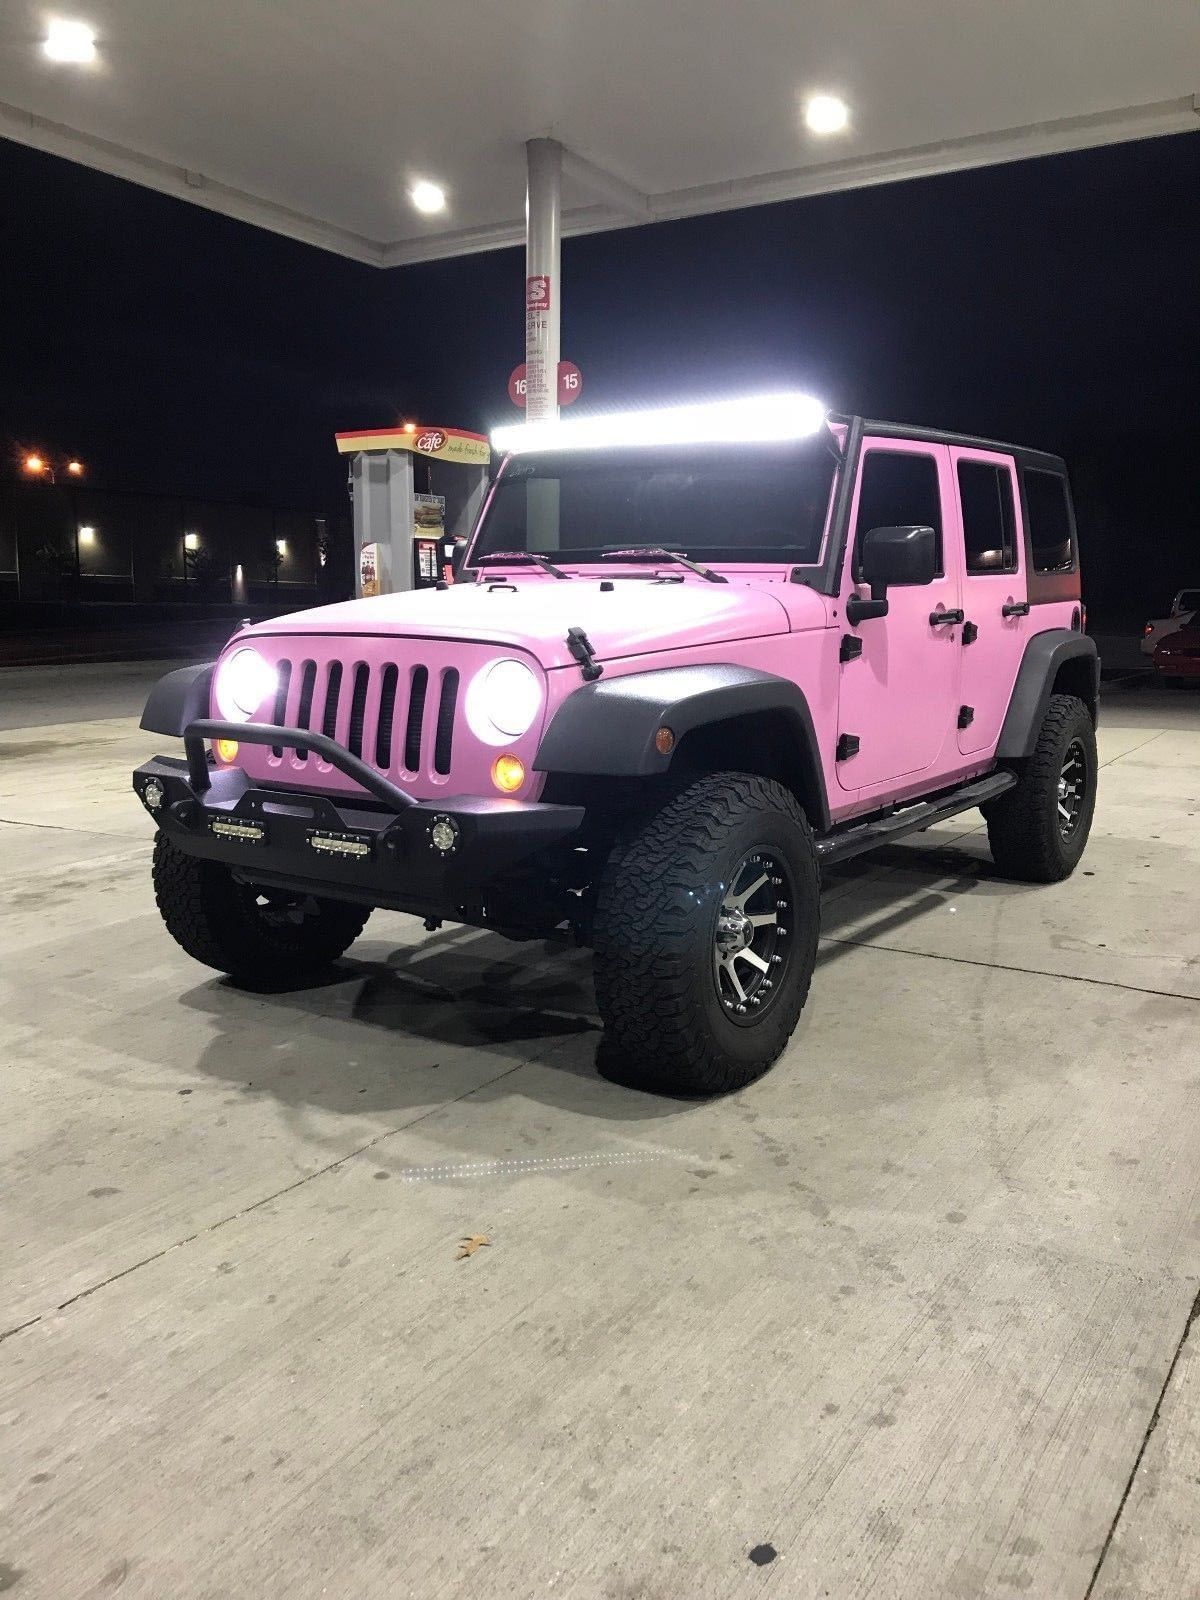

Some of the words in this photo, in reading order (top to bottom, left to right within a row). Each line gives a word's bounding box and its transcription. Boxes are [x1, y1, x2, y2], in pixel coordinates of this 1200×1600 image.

[527, 320, 547, 330] ERVE
[514, 379, 527, 394] 16
[563, 373, 578, 389] 15
